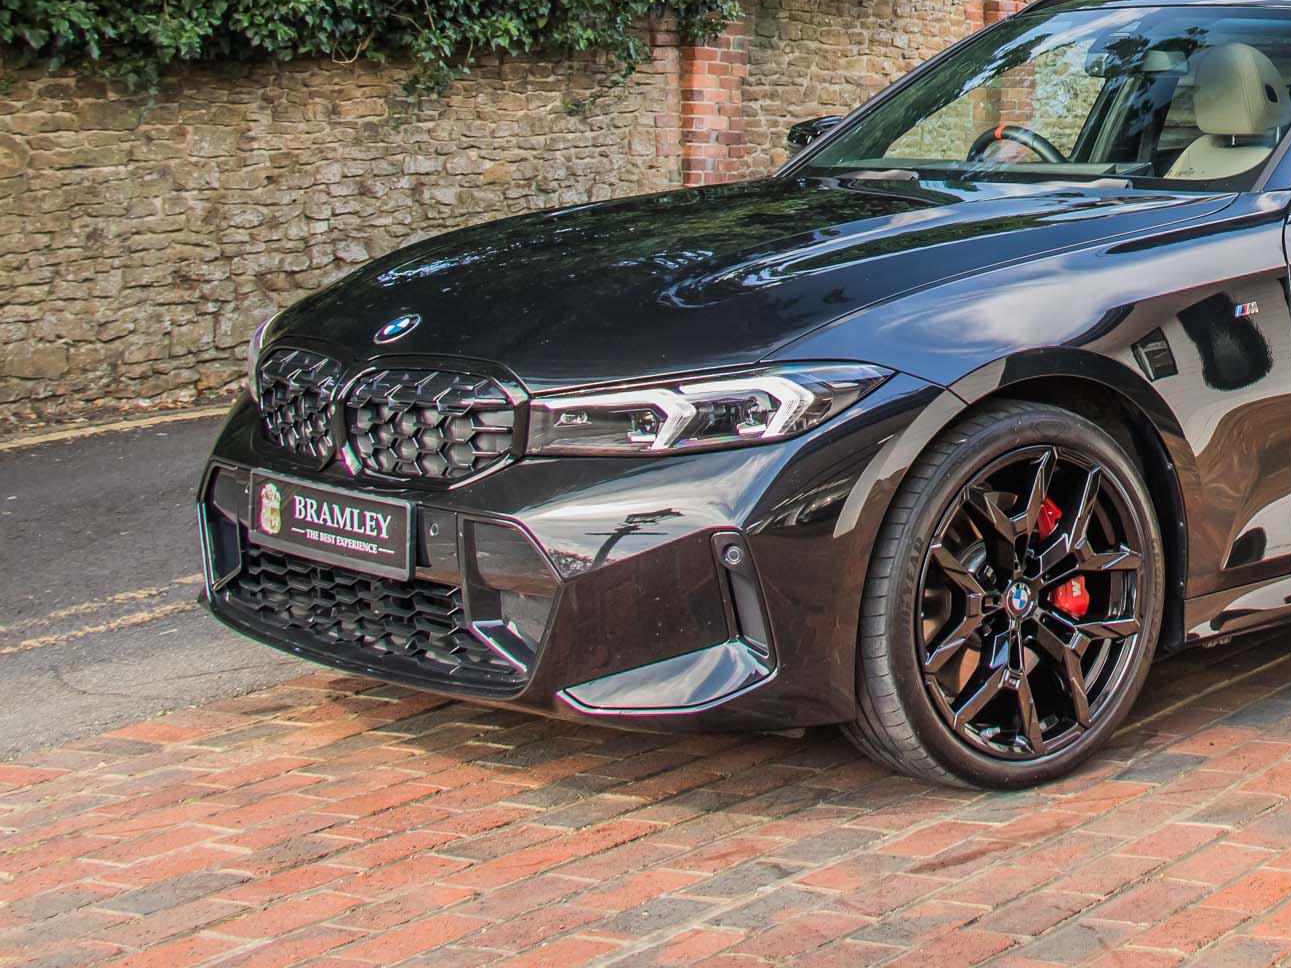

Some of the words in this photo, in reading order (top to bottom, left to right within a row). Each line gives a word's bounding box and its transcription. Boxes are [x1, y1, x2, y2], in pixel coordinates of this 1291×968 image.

[293, 495, 392, 539] BRAMLEY
[306, 529, 319, 540] THE
[320, 531, 336, 544] BEST
[336, 536, 379, 553] EXPERIENCE
